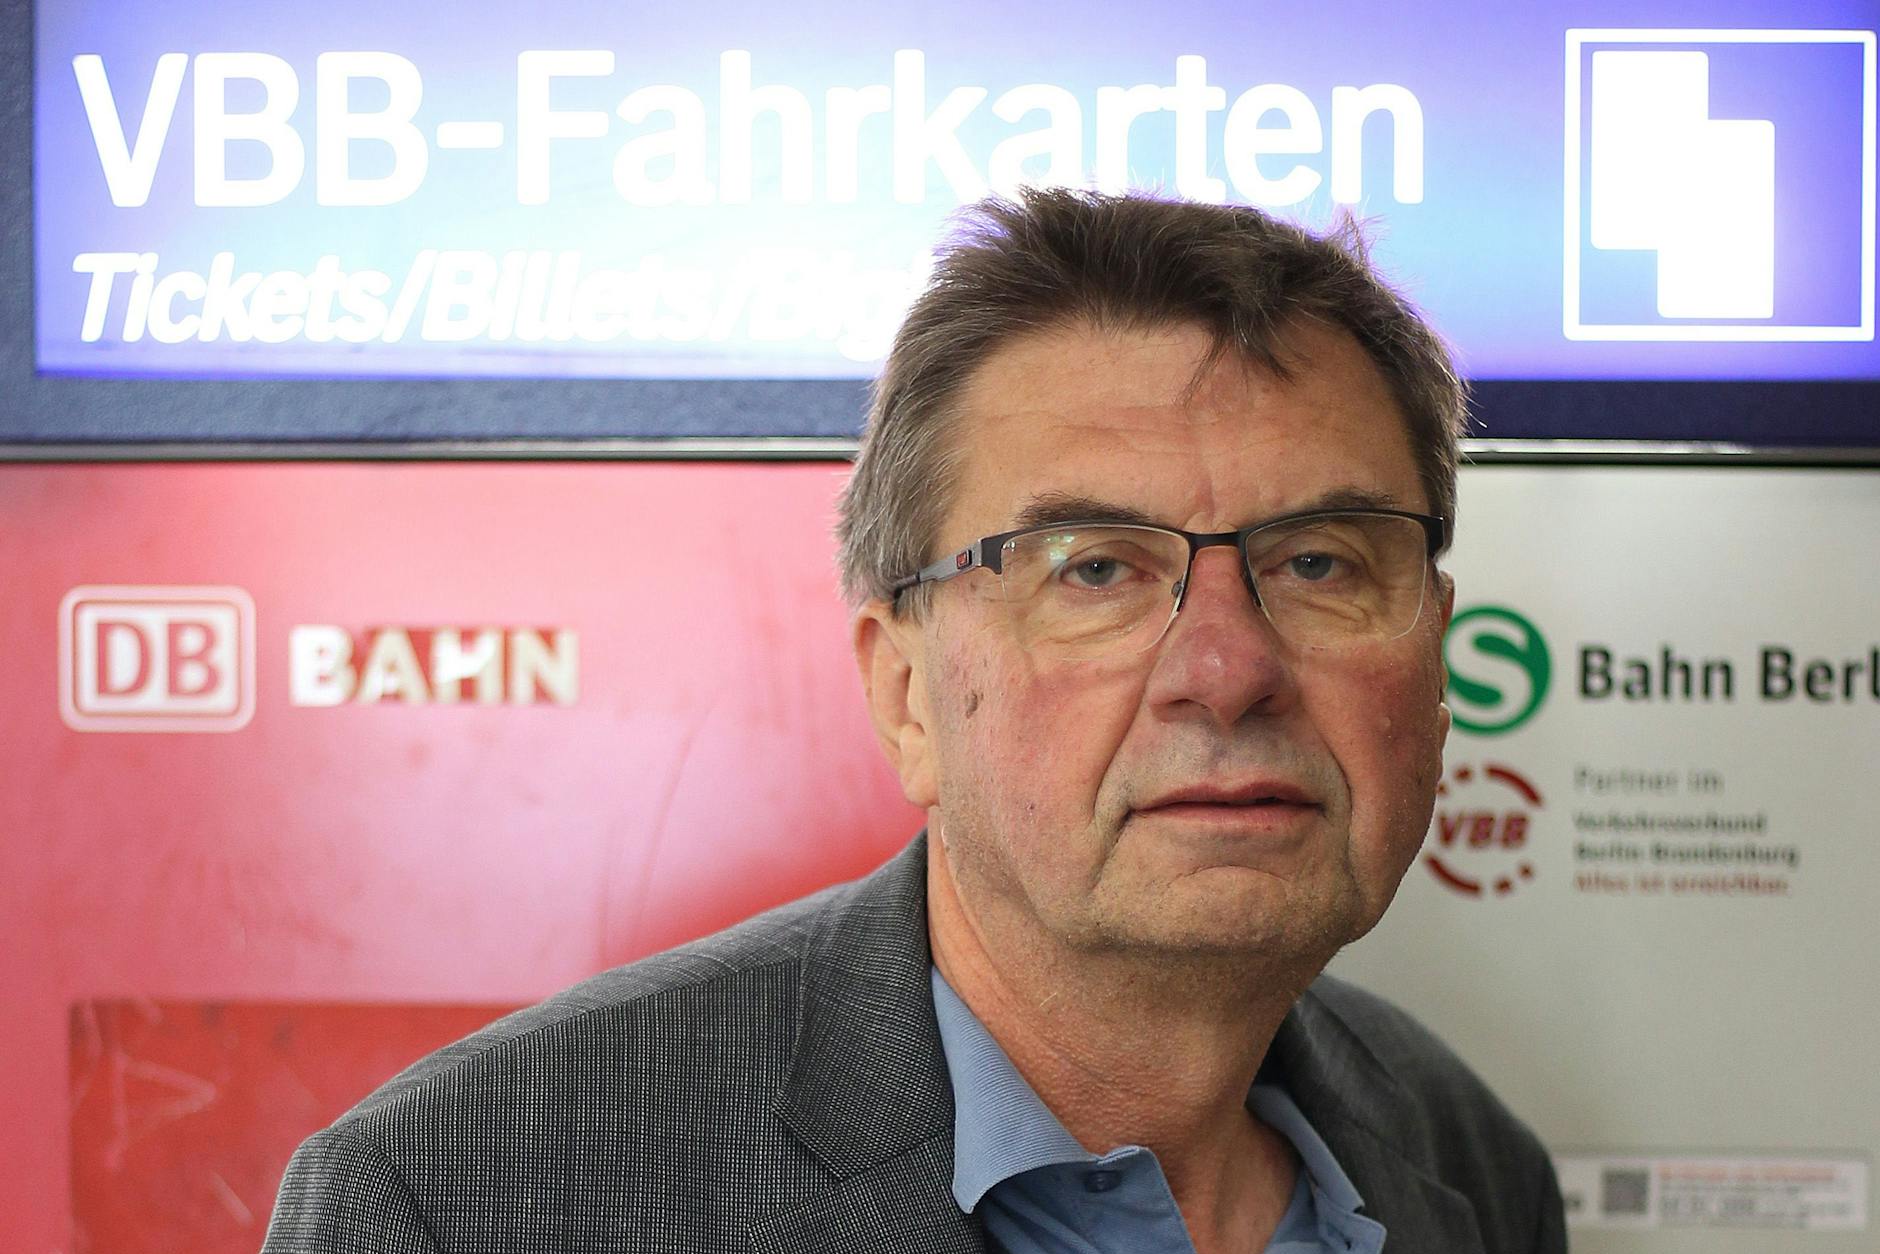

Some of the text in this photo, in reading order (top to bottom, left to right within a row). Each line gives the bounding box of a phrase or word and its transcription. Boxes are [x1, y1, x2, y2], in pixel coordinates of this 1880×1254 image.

[71, 47, 1423, 207] VBB-Fahrkarten
[96, 621, 580, 707] DB BAHN
[1578, 645, 1733, 701] Bahn
[1438, 813, 1529, 848] VBB
